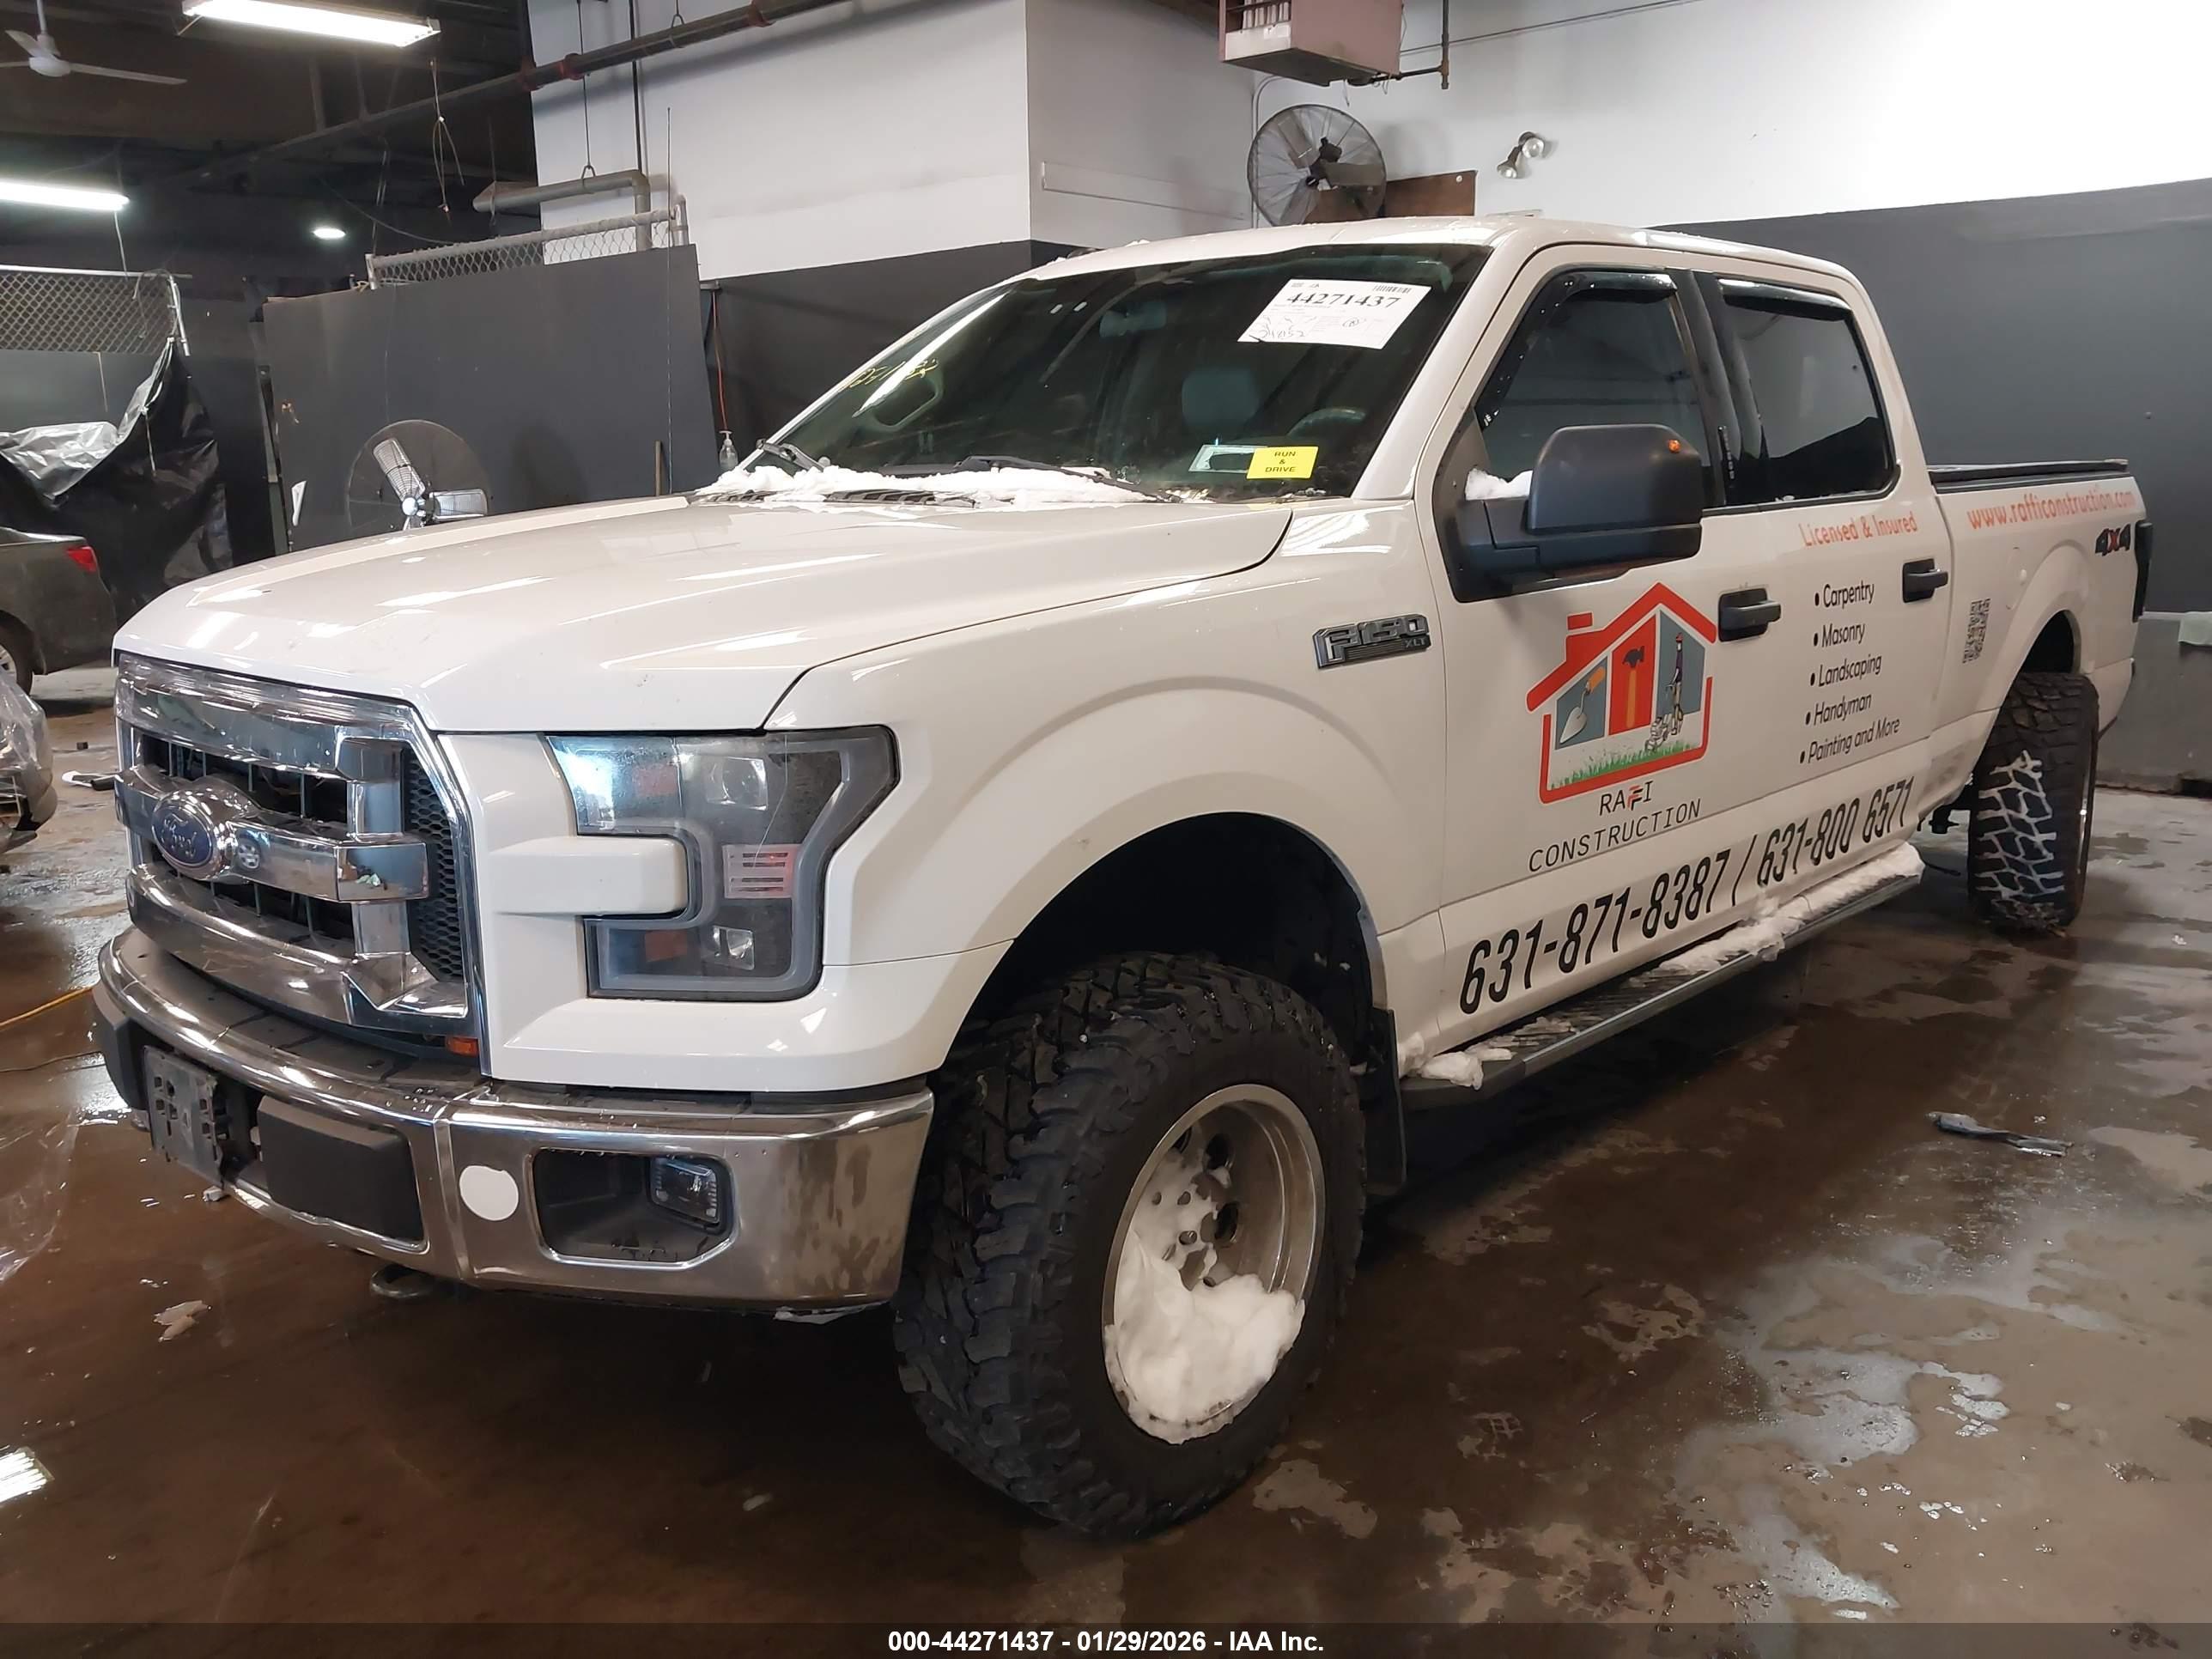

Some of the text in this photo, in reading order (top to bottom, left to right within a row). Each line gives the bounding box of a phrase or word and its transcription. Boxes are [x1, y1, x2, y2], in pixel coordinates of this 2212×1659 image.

[1287, 292, 1401, 308] 44271437
[1967, 486, 2136, 529] www.rafficonstruction.com
[1799, 511, 1917, 547] Licensed & Insured
[1823, 580, 1875, 609] Carpentry
[1405, 637, 1426, 648] XLT
[1821, 623, 1866, 647] Masonry
[1819, 653, 1882, 687] Landscaping
[1814, 695, 1872, 726] Handyman
[1808, 717, 1900, 763] Painting and More
[1528, 799, 1701, 872] CONSTRUCTION
[1460, 775, 1915, 1015] 631-871-8387 / 631-800 6571
